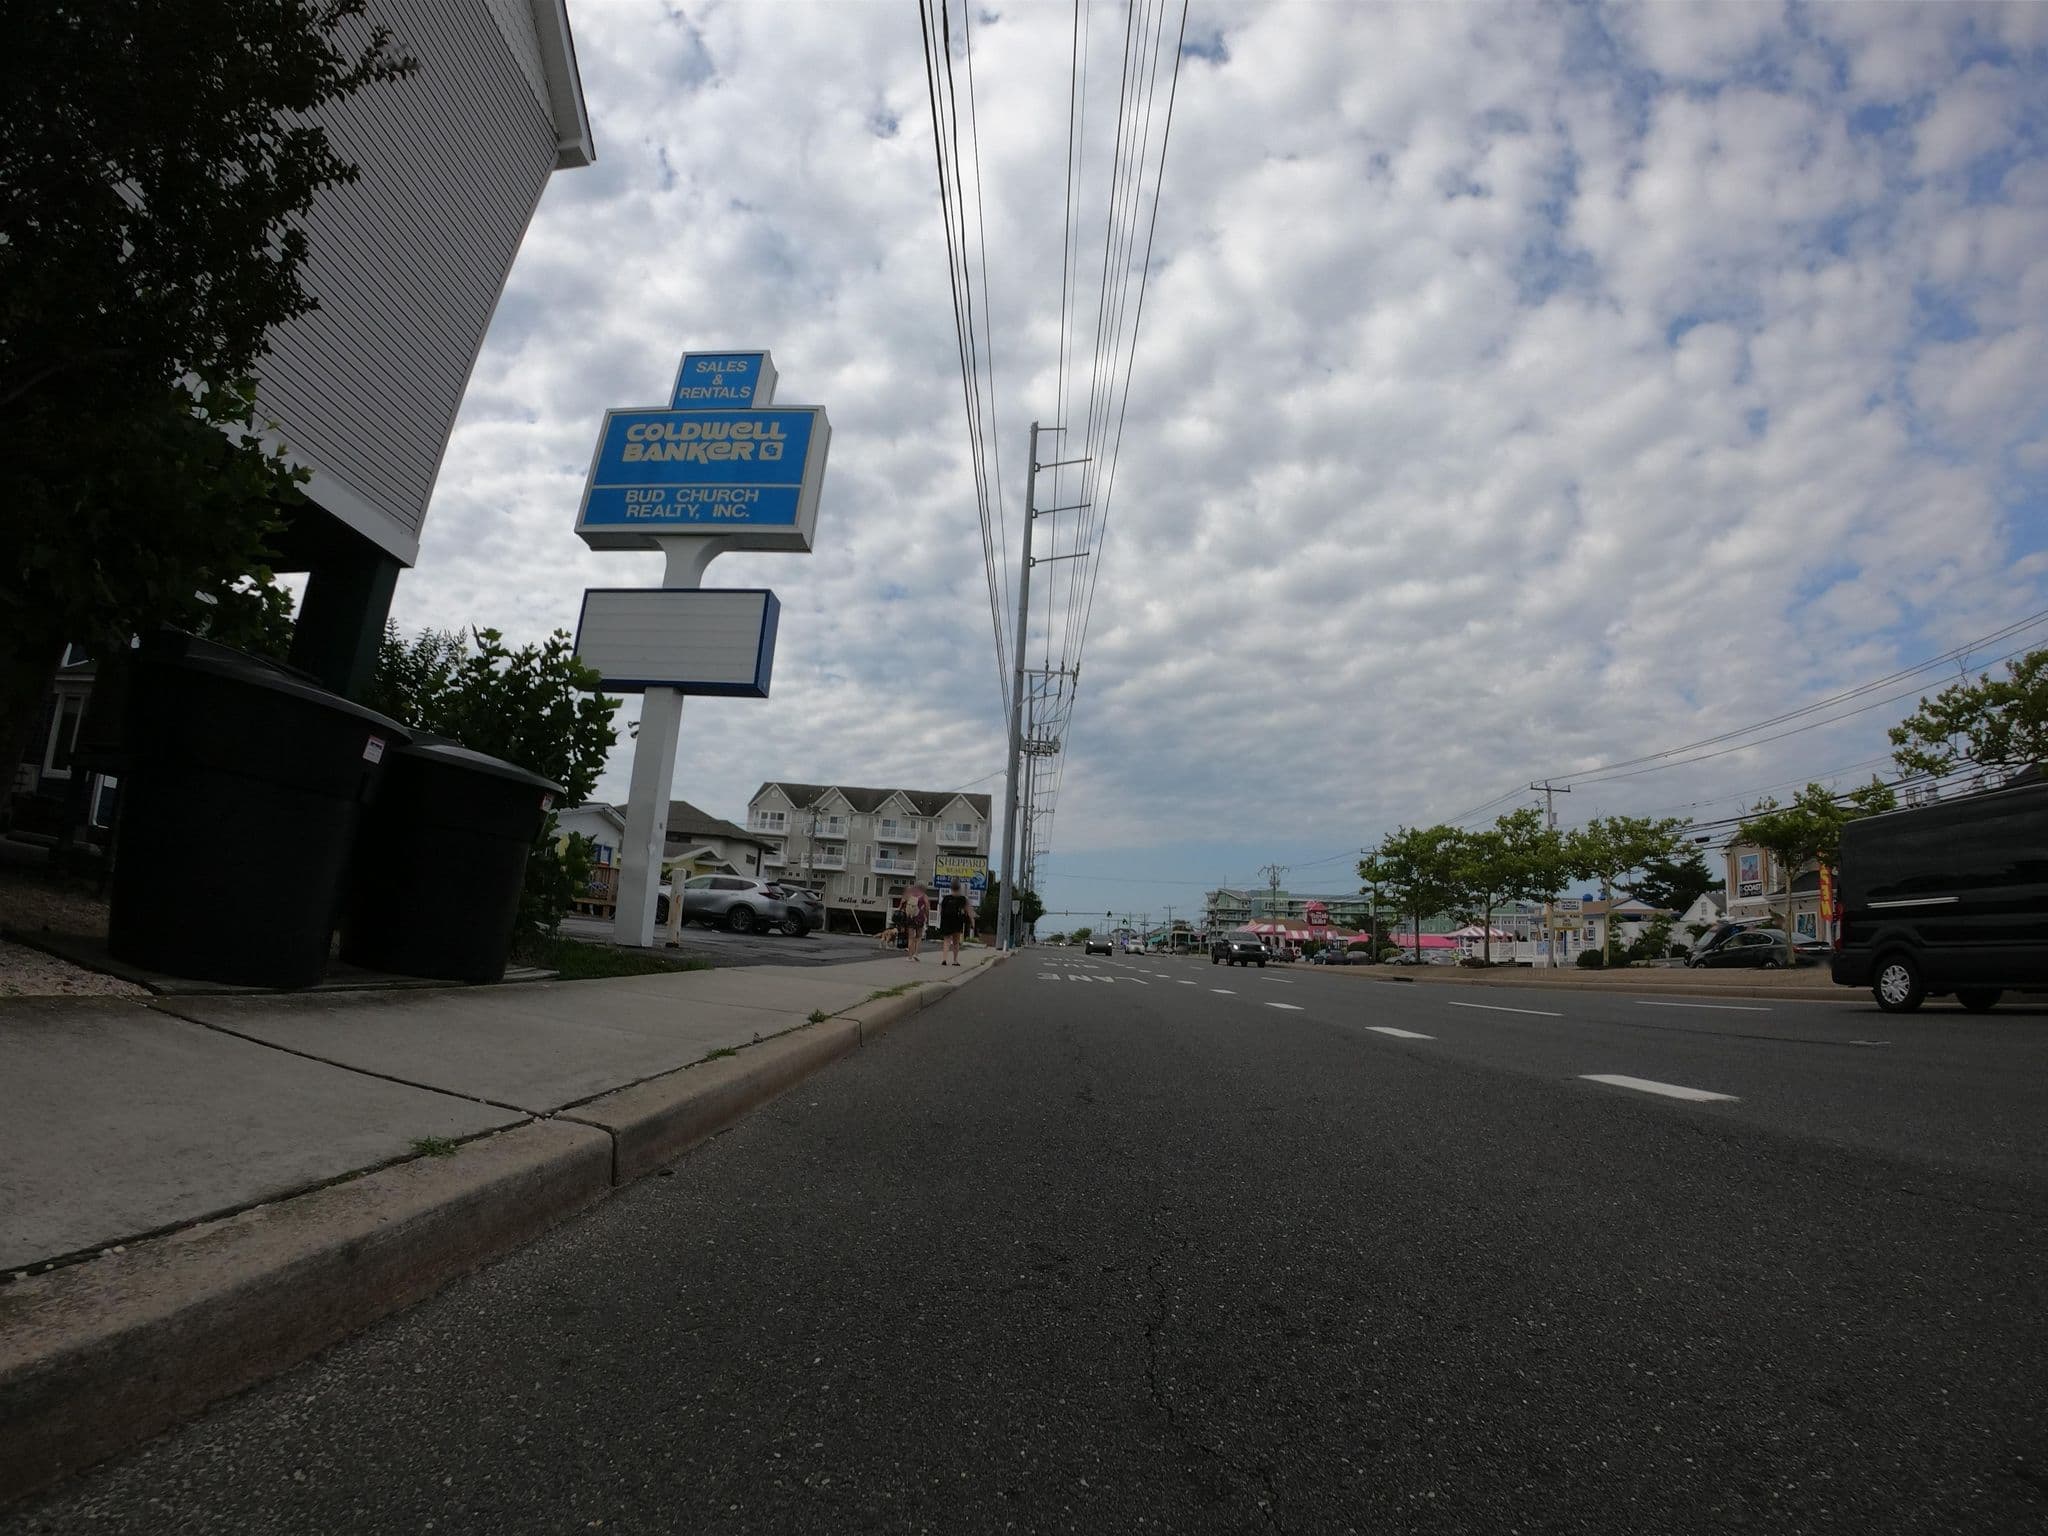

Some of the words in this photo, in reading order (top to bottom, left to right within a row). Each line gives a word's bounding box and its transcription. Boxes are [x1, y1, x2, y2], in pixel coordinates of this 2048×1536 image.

[696, 360, 748, 373] SALES
[712, 374, 723, 386] &
[679, 386, 751, 400] RENTALS
[627, 422, 786, 441] COLDWELL
[622, 442, 754, 464] BANKER
[624, 489, 665, 503] BUD
[676, 488, 759, 502] CHURCH
[625, 504, 700, 519] REALTY,
[712, 504, 750, 518] INC.
[939, 856, 985, 868] SHEPPARD
